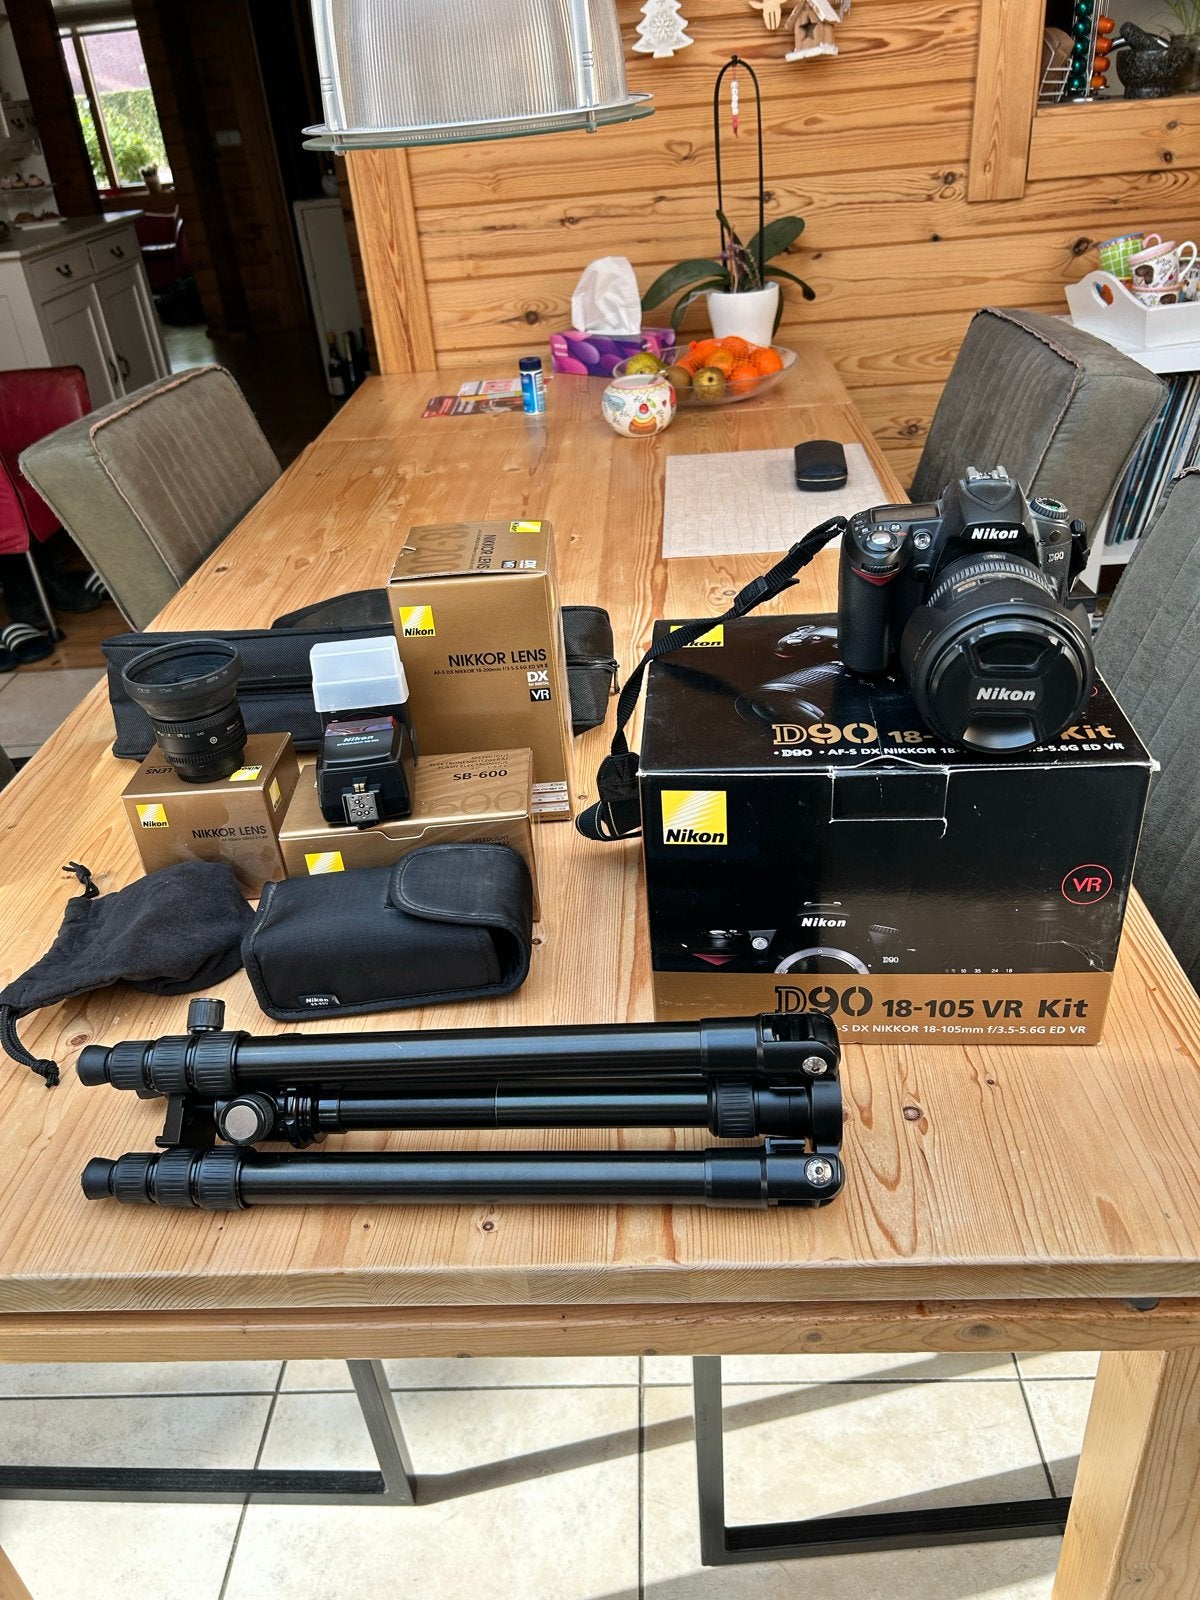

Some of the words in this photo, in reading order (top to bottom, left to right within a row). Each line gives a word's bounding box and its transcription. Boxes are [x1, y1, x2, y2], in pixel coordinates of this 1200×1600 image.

[970, 527, 1019, 540] Nikon
[480, 534, 497, 555] NIKKOR
[1047, 551, 1065, 563] D90
[404, 628, 434, 637] Nikon
[448, 651, 506, 667] NIKKOR
[511, 648, 547, 663] LENS
[527, 670, 549, 682] DX
[531, 689, 550, 700] VR
[976, 686, 1036, 701] Nikon
[343, 735, 375, 743] Nikon
[772, 722, 878, 745] D90
[888, 730, 933, 743] 18-
[1061, 725, 1116, 740] Kit
[782, 749, 813, 757] D90
[827, 748, 858, 756] AF-S
[883, 747, 937, 755] NIKKOR
[1082, 743, 1101, 751] ED
[453, 769, 508, 780] SB-600
[143, 820, 167, 828] Nikon
[192, 827, 236, 839] NIKKOR
[240, 825, 267, 836] LENS
[665, 829, 725, 844] Nikon
[1072, 877, 1102, 892] VR
[801, 917, 847, 928] Nikon
[882, 956, 899, 964] D90
[775, 986, 873, 1017] D90
[881, 999, 974, 1018] 18-105
[982, 999, 1023, 1018] VR
[1038, 998, 1088, 1018] Kit
[852, 1024, 869, 1032] DX
[872, 1024, 919, 1033] NIKKOR
[923, 1025, 984, 1033] 18-105mm
[987, 1025, 1046, 1034] f/3.5-5.6G
[1050, 1025, 1066, 1034] ED
[1069, 1025, 1086, 1034] VR
